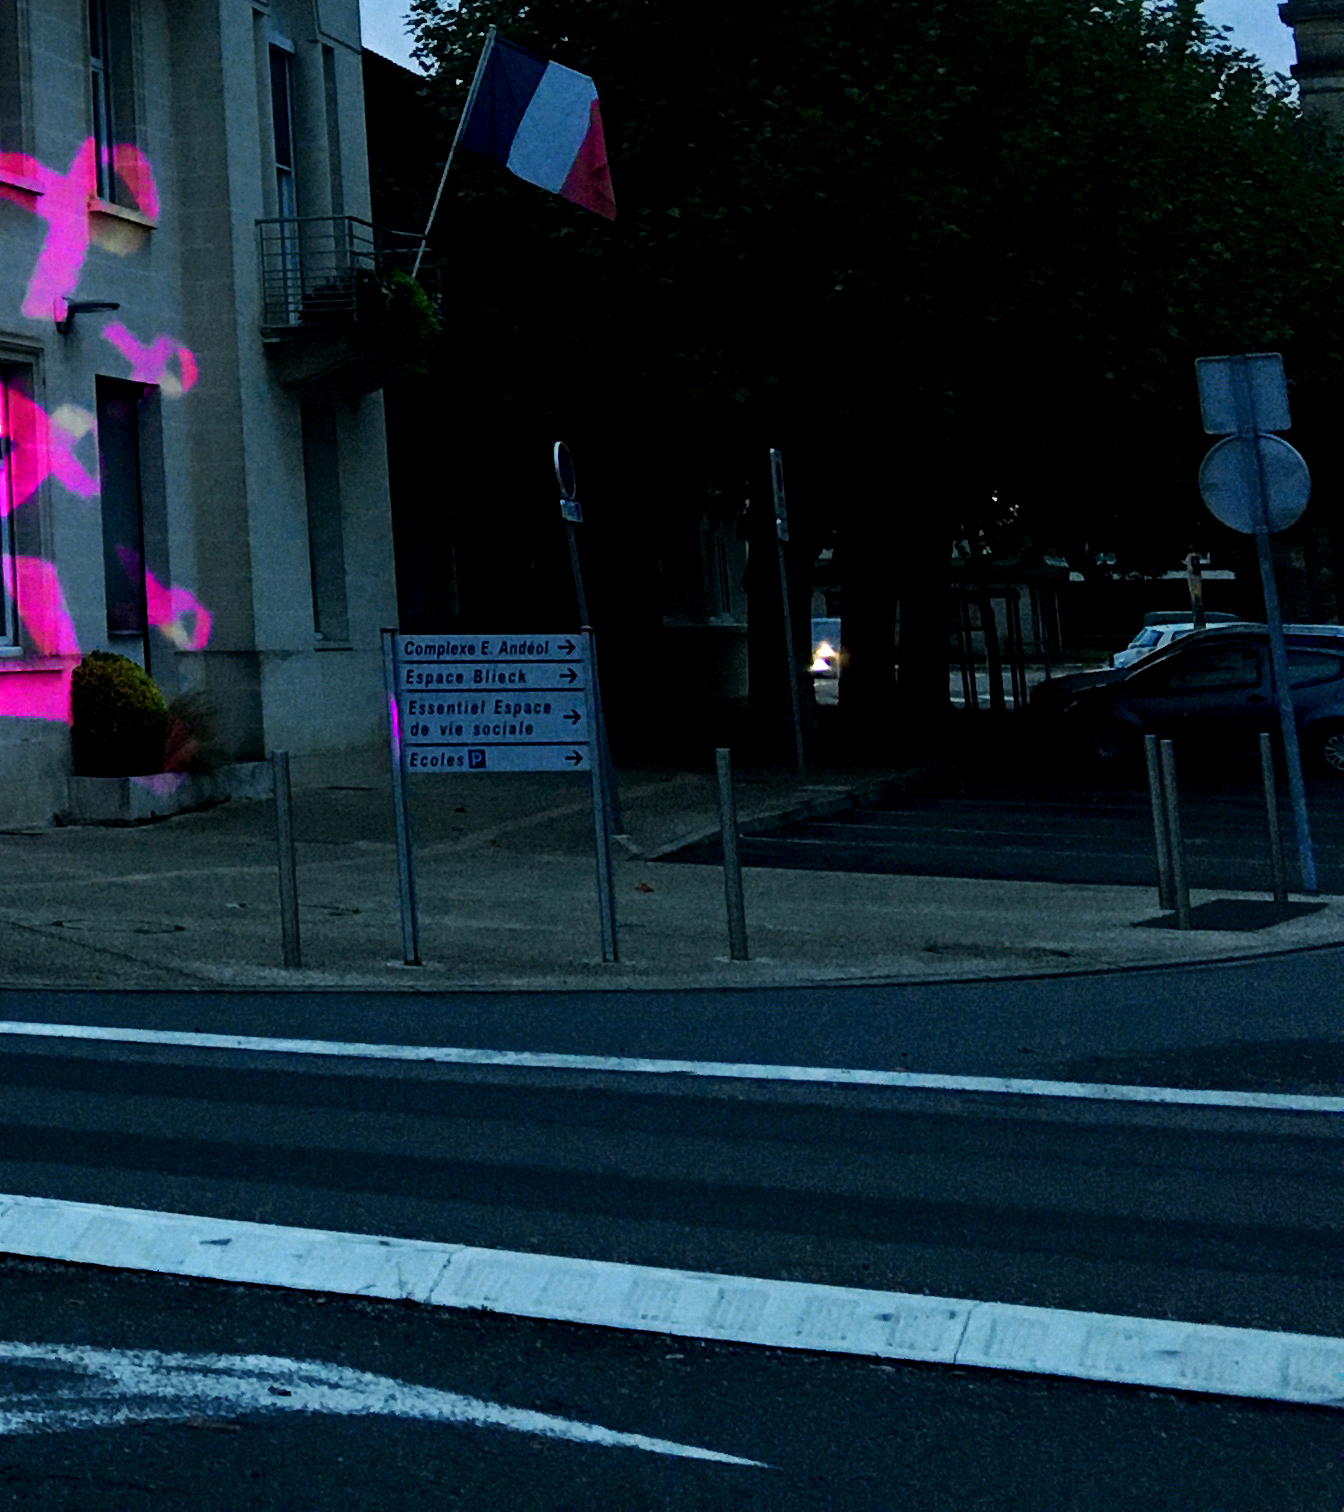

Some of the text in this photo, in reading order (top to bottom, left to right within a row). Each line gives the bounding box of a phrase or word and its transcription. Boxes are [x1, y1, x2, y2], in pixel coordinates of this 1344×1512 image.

[404, 641, 549, 659] Complexe E. Andéol
[406, 669, 527, 687] Espace Blieck
[408, 699, 552, 717] Essentiel Espace
[410, 721, 534, 737] de vie sociale
[410, 752, 464, 767] Ecoles
